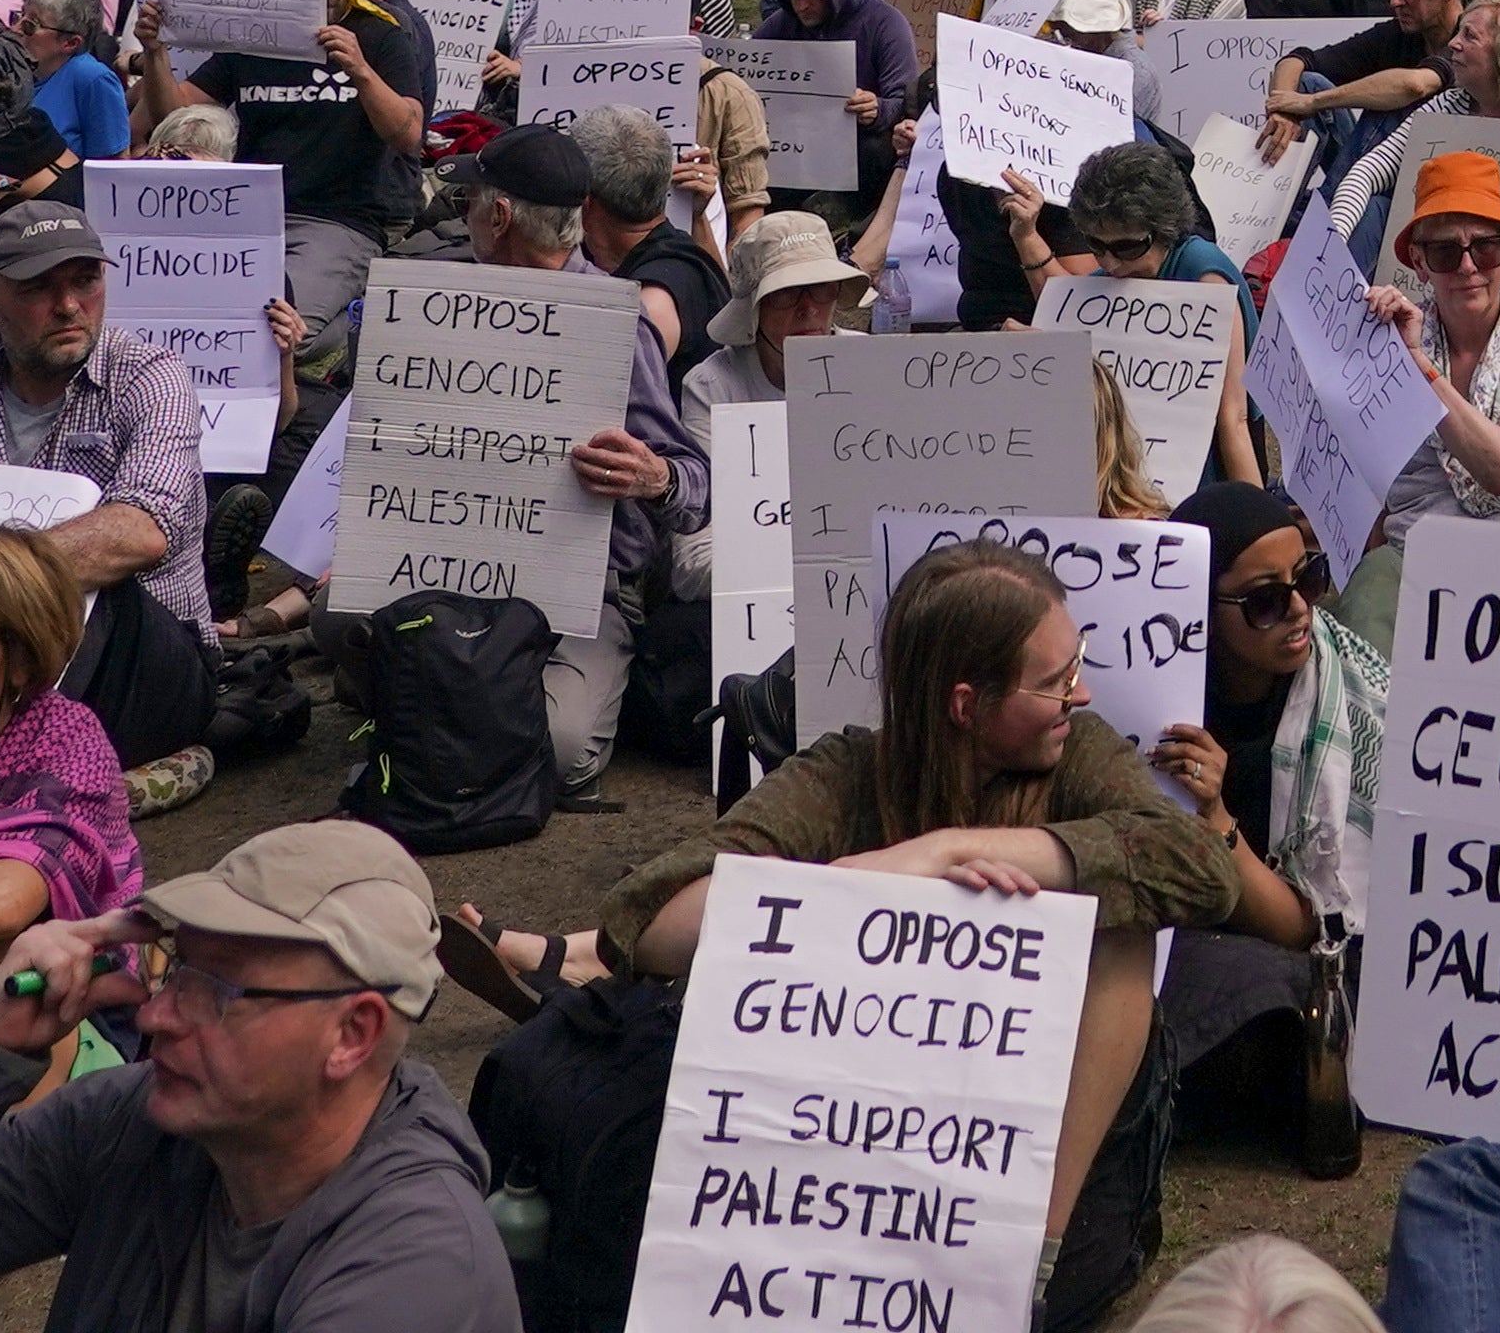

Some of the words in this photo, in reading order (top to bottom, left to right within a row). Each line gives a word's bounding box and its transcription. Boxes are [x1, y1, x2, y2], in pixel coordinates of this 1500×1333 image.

[195, 15, 280, 47] ACTION
[239, 86, 358, 104] KNEECAP
[573, 61, 682, 85] OPPOSE
[982, 49, 1052, 79] OPPOSE
[1060, 69, 1128, 116] GENOCIDE
[999, 92, 1071, 136] SUPPORT
[959, 113, 1065, 168] PALESTINE
[137, 184, 247, 222] OPPOSE
[21, 219, 65, 240] AUTRY
[780, 231, 817, 247] MUSTO
[119, 242, 257, 286] GENOCIDE
[422, 289, 562, 339] OPPOSE
[1081, 294, 1218, 342] OPPOSE
[375, 353, 563, 405] GENOCIDE
[903, 354, 1057, 389] OPPOSE
[413, 423, 573, 466] SUPPORT
[833, 426, 1035, 462] GENOCIDE
[367, 483, 547, 535] PALESTINE
[389, 553, 517, 598] ACTION
[856, 905, 1044, 983] OPPOSE
[733, 979, 1034, 1059] GENOCIDE
[789, 1092, 1029, 1178] SUPPORT
[689, 1166, 979, 1249] PALESTINE
[708, 1261, 957, 1333] ACTION
